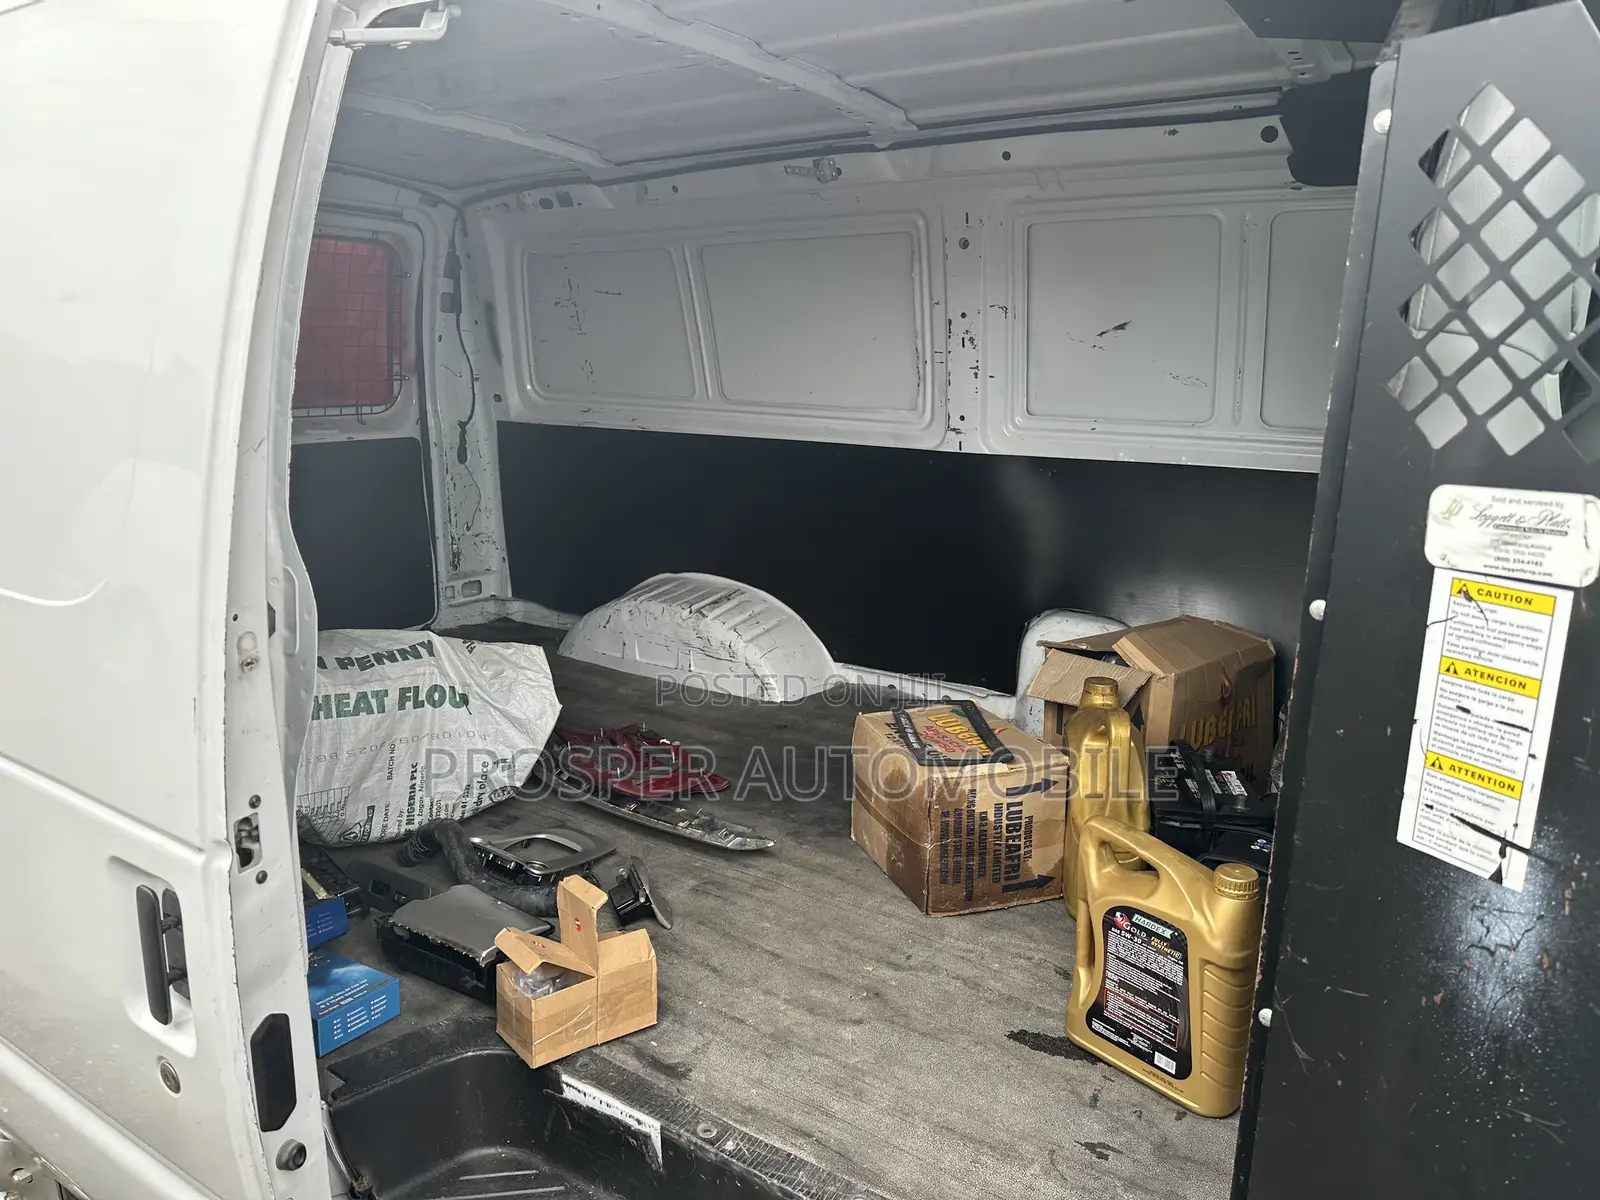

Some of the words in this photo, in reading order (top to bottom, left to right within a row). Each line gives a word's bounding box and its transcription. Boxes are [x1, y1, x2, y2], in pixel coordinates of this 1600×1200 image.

[1477, 588, 1533, 606] CAUTION
[335, 640, 435, 671] PENNY
[311, 689, 388, 720] HEAT
[398, 684, 471, 713] FLOU
[386, 755, 395, 780] BATCH
[410, 762, 418, 781] PLC
[475, 761, 489, 789] place
[1448, 763, 1516, 793] ATTENTION
[406, 783, 417, 825] NIGERIA
[473, 792, 486, 806] dry
[979, 811, 988, 822] KM
[993, 803, 1003, 847] INDUSTRY
[1004, 801, 1023, 881] LUBEAFRI
[1023, 815, 1033, 850] PRODUCE
[992, 849, 1002, 884] LIMITED
[1023, 850, 1032, 862] BY:
[1121, 930, 1142, 944] 5W-30
[1123, 921, 1147, 938] GOLD
[1134, 916, 1168, 934] HARDEX
[1150, 936, 1168, 947] FULLY
